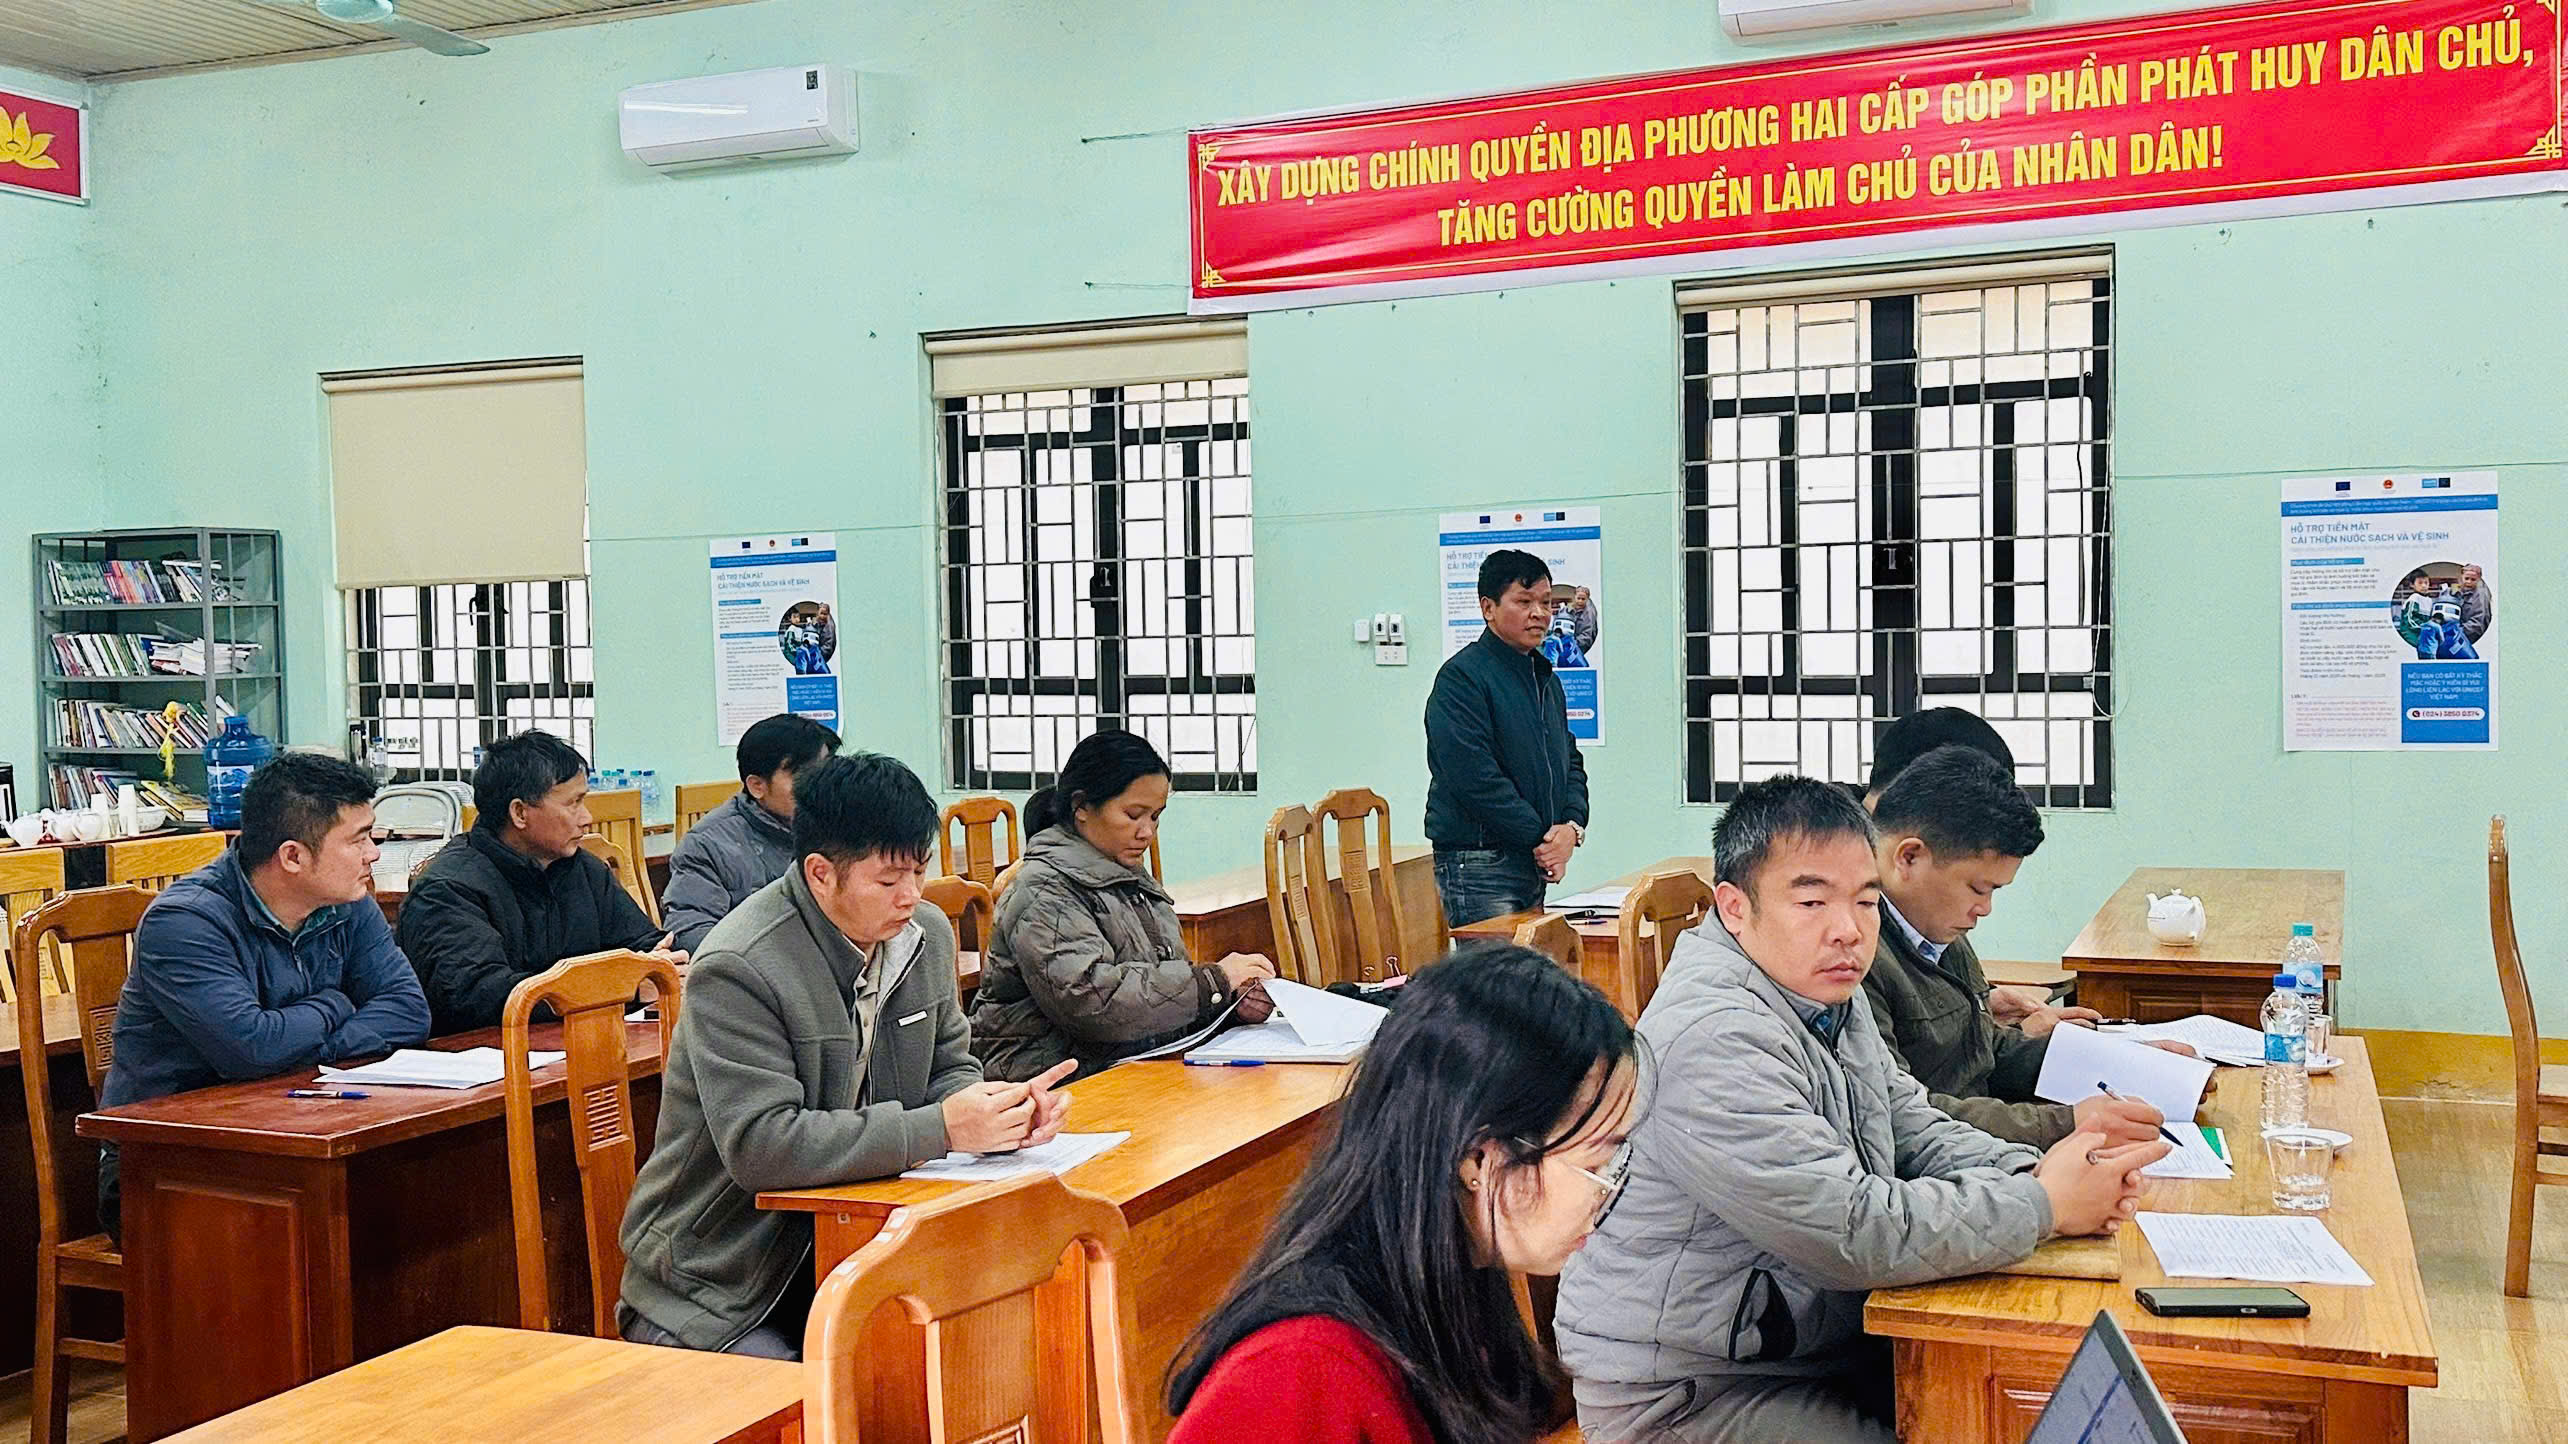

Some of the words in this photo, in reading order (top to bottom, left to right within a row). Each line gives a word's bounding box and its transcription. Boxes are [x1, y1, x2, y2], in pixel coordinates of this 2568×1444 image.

[1217, 161, 1272, 206] XÂY
[1280, 155, 1361, 205] DỰNG
[1368, 139, 1461, 191] CHÍNH
[1469, 120, 1572, 183] QUYỀN
[1580, 124, 1636, 173] ĐỊA
[1643, 105, 1780, 160] PHƯƠNG
[1790, 96, 1848, 143] HAI
[1858, 74, 1931, 135] CẤP
[1940, 71, 2013, 123] GÓP
[2025, 52, 2129, 115] PHẦN
[2139, 45, 2240, 102] PHÁT
[2250, 41, 2328, 92] HUY
[2340, 24, 2425, 82] DÂN
[2436, 5, 2534, 71] CHỦ,
[1437, 199, 1518, 246] TĂNG
[1526, 185, 1635, 238] CƯỜNG
[1644, 165, 1753, 229] QUYỀN
[1762, 162, 1836, 213] LÀM
[1846, 144, 1918, 205] CHỦ
[1928, 138, 2002, 196] CỦA
[2012, 130, 2118, 187] NHÂN
[2128, 121, 2223, 176] DÂN!
[2426, 531, 2449, 540] SINH
